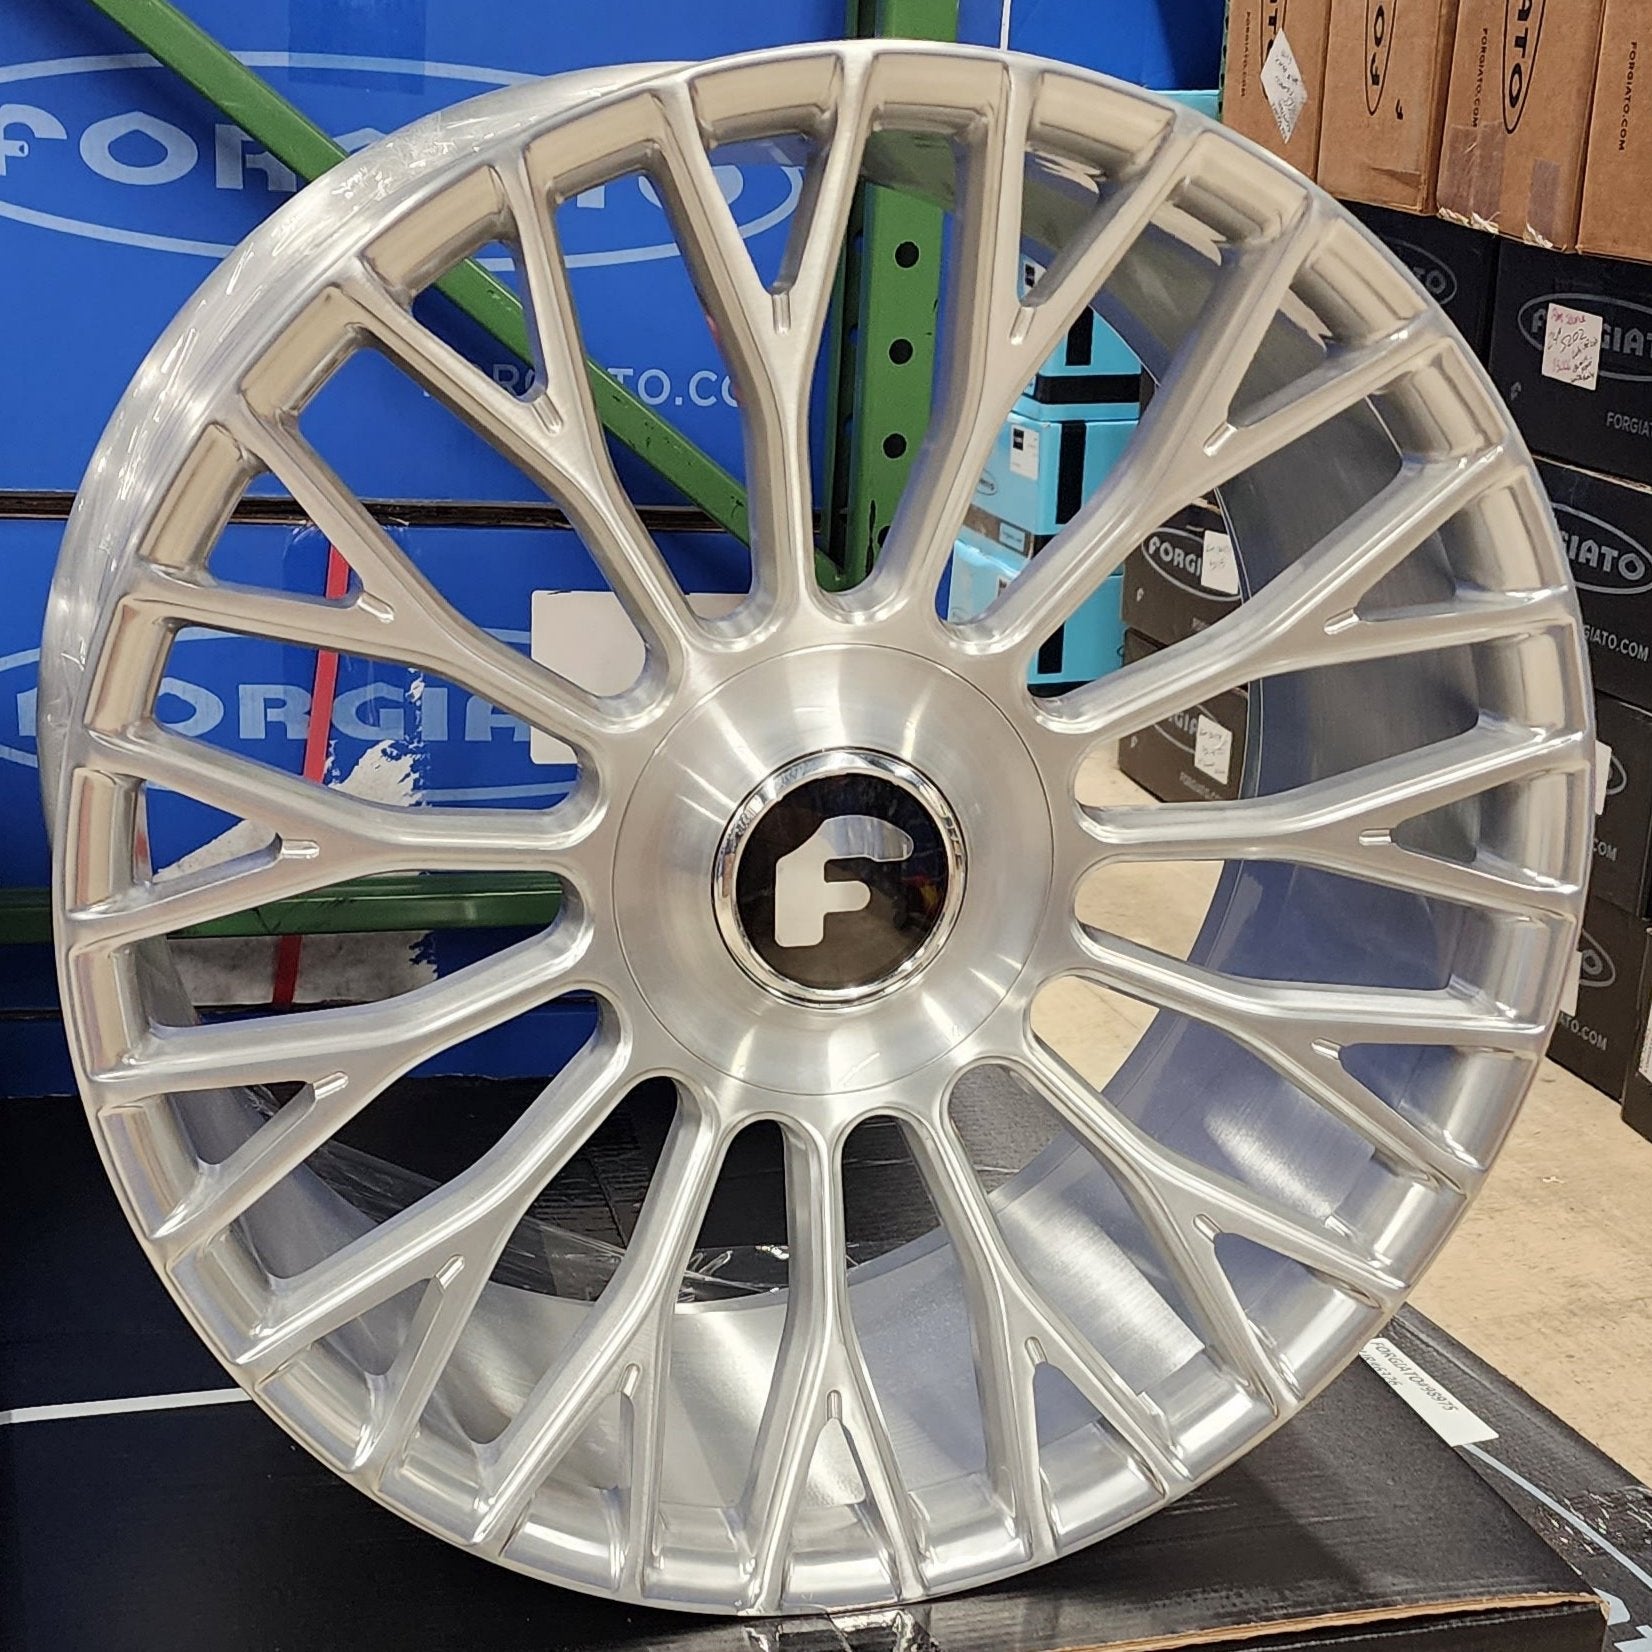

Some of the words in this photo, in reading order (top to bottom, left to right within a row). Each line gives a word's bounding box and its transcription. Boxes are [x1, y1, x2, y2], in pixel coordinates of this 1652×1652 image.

[1471, 27, 1488, 128] FORGIATO.COM
[1618, 41, 1637, 151] FORGIATO.COM
[1148, 535, 1202, 577] FORGI
[1583, 625, 1649, 662] GIATO.COM
[1559, 1013, 1607, 1051] ATO.COM
